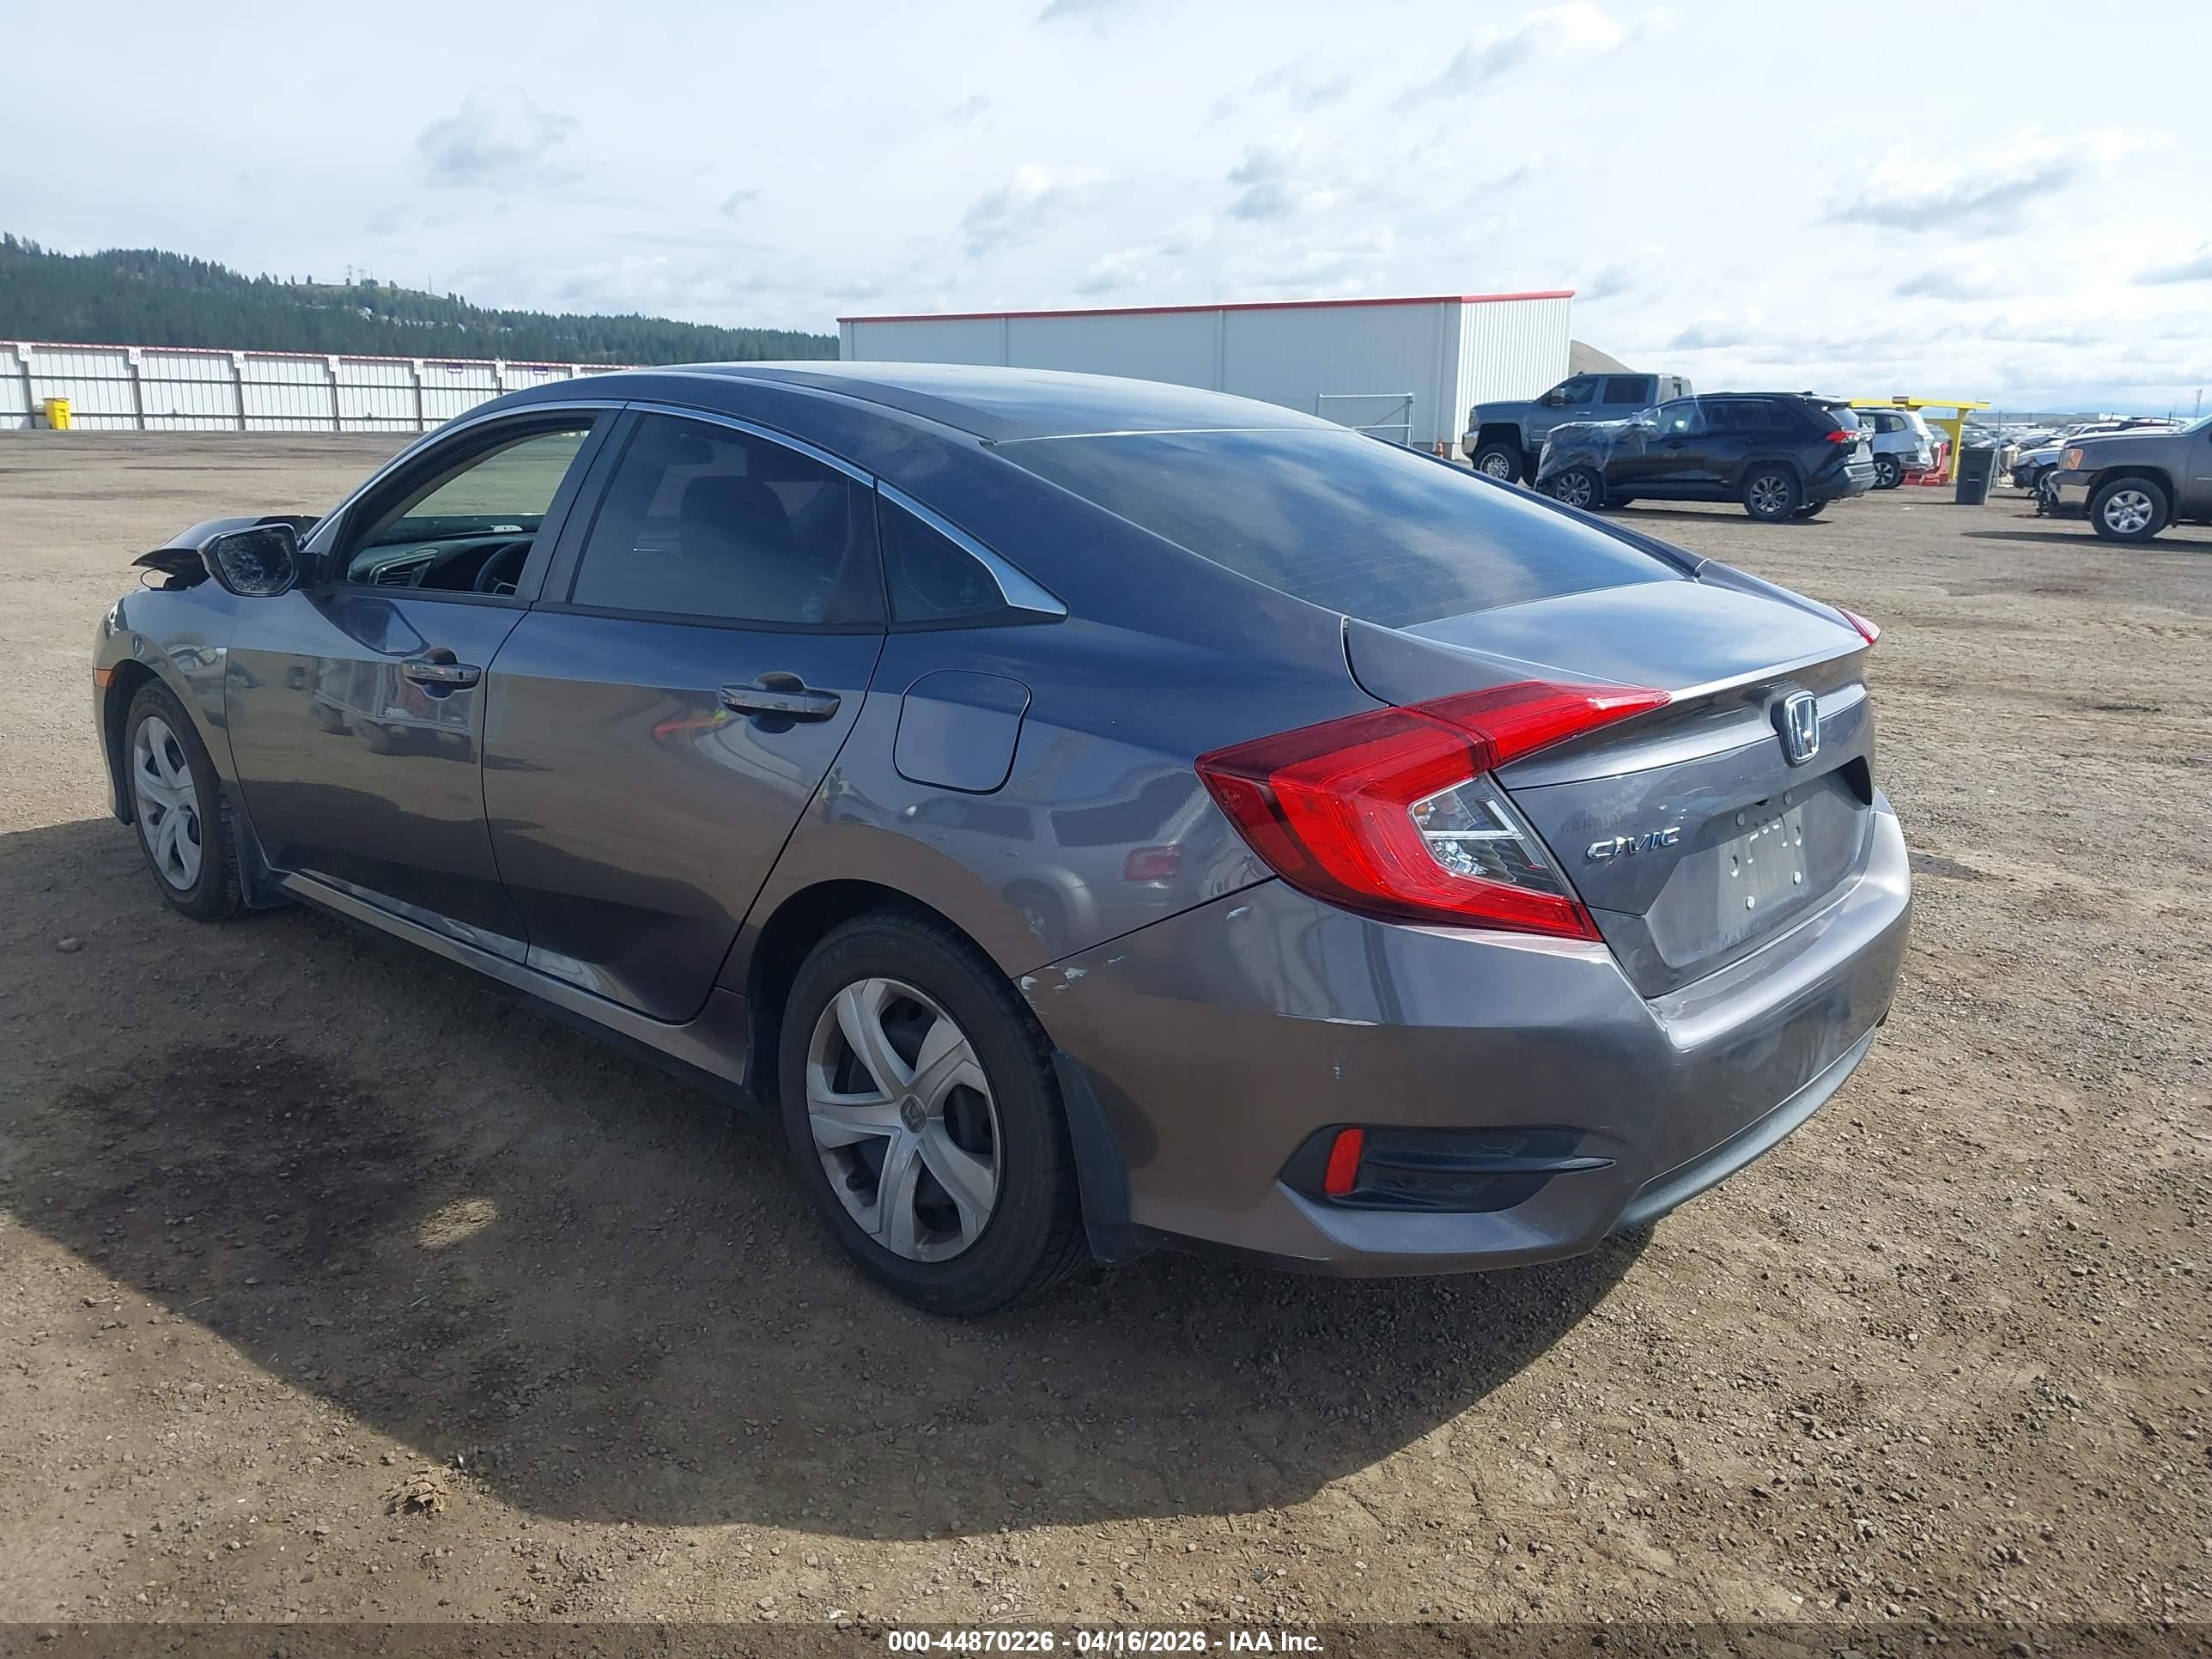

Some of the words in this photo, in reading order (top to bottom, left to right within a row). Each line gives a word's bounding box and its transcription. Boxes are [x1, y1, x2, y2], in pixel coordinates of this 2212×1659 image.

[131, 351, 140, 360] 25
[330, 359, 338, 368] 27
[1587, 827, 1680, 860] CIVIC
